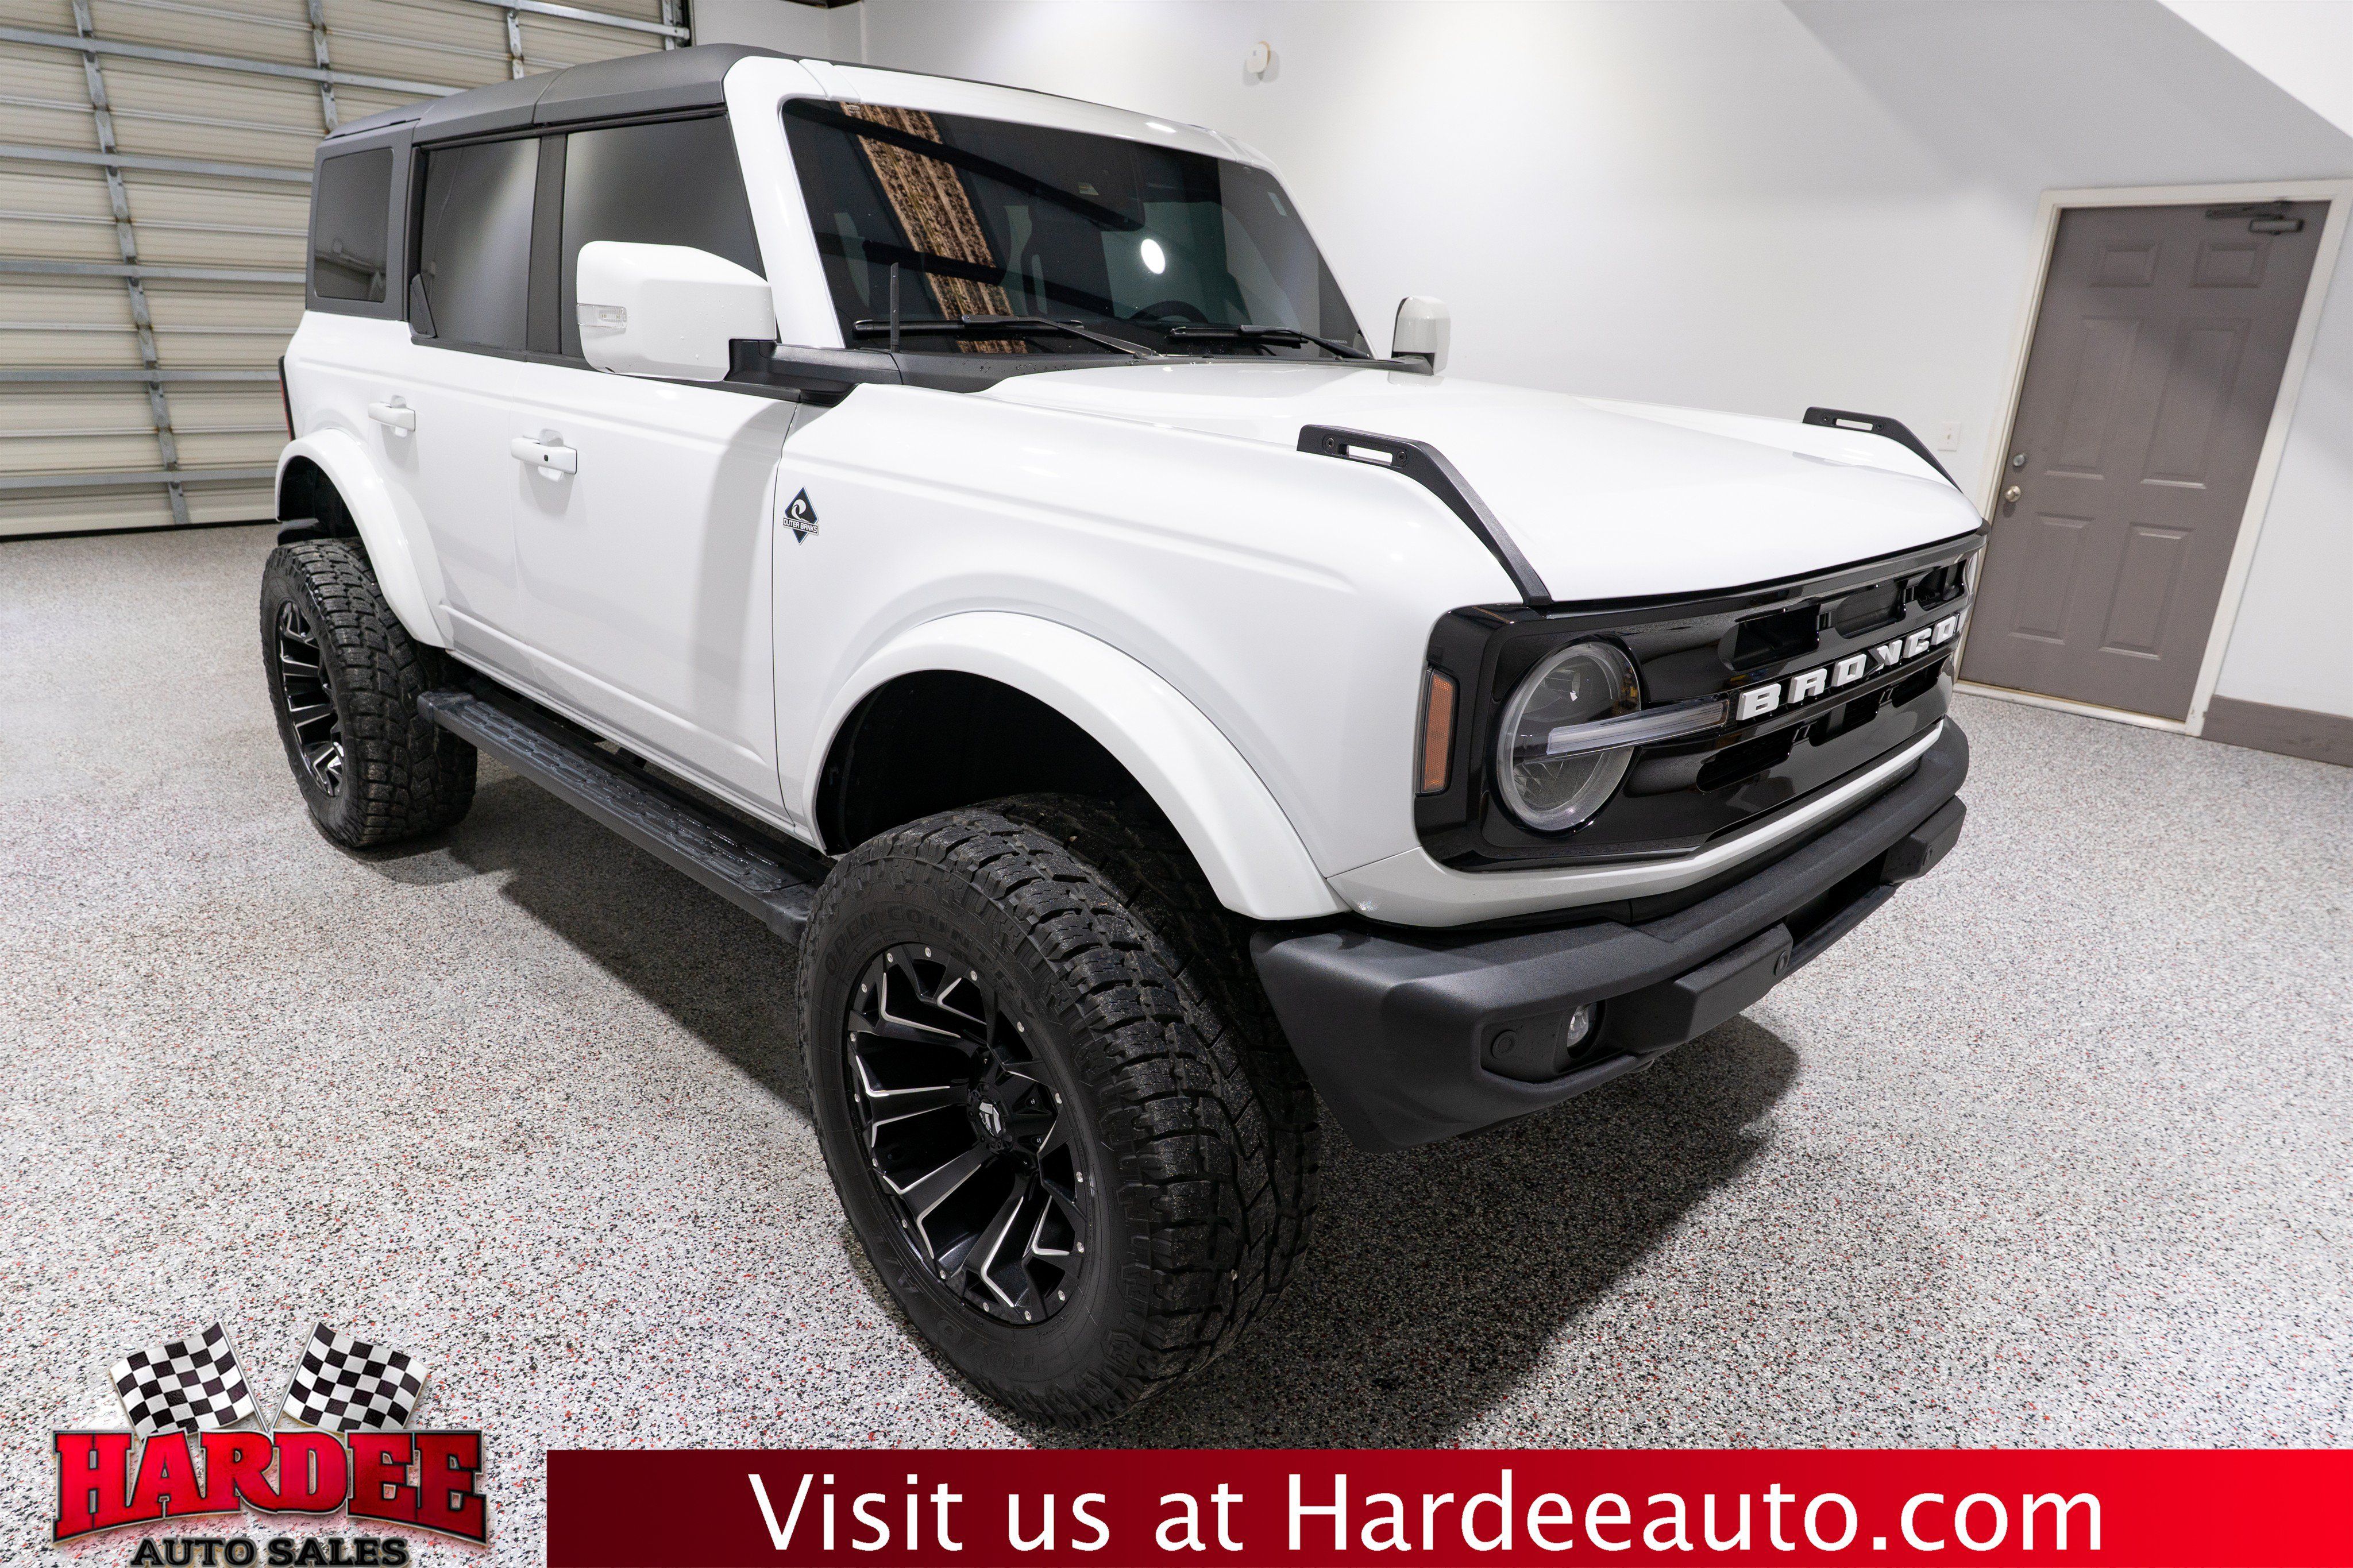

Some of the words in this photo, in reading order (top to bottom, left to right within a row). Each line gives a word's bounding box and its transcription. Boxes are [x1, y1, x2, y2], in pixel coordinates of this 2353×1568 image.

[784, 519, 800, 528] OUTER
[800, 523, 817, 532] BANKS
[1736, 616, 1957, 721] BRONCO
[826, 909, 879, 976] OPEN
[888, 905, 1036, 1019] COUNTRY
[936, 1316, 1040, 1373] TOYO
